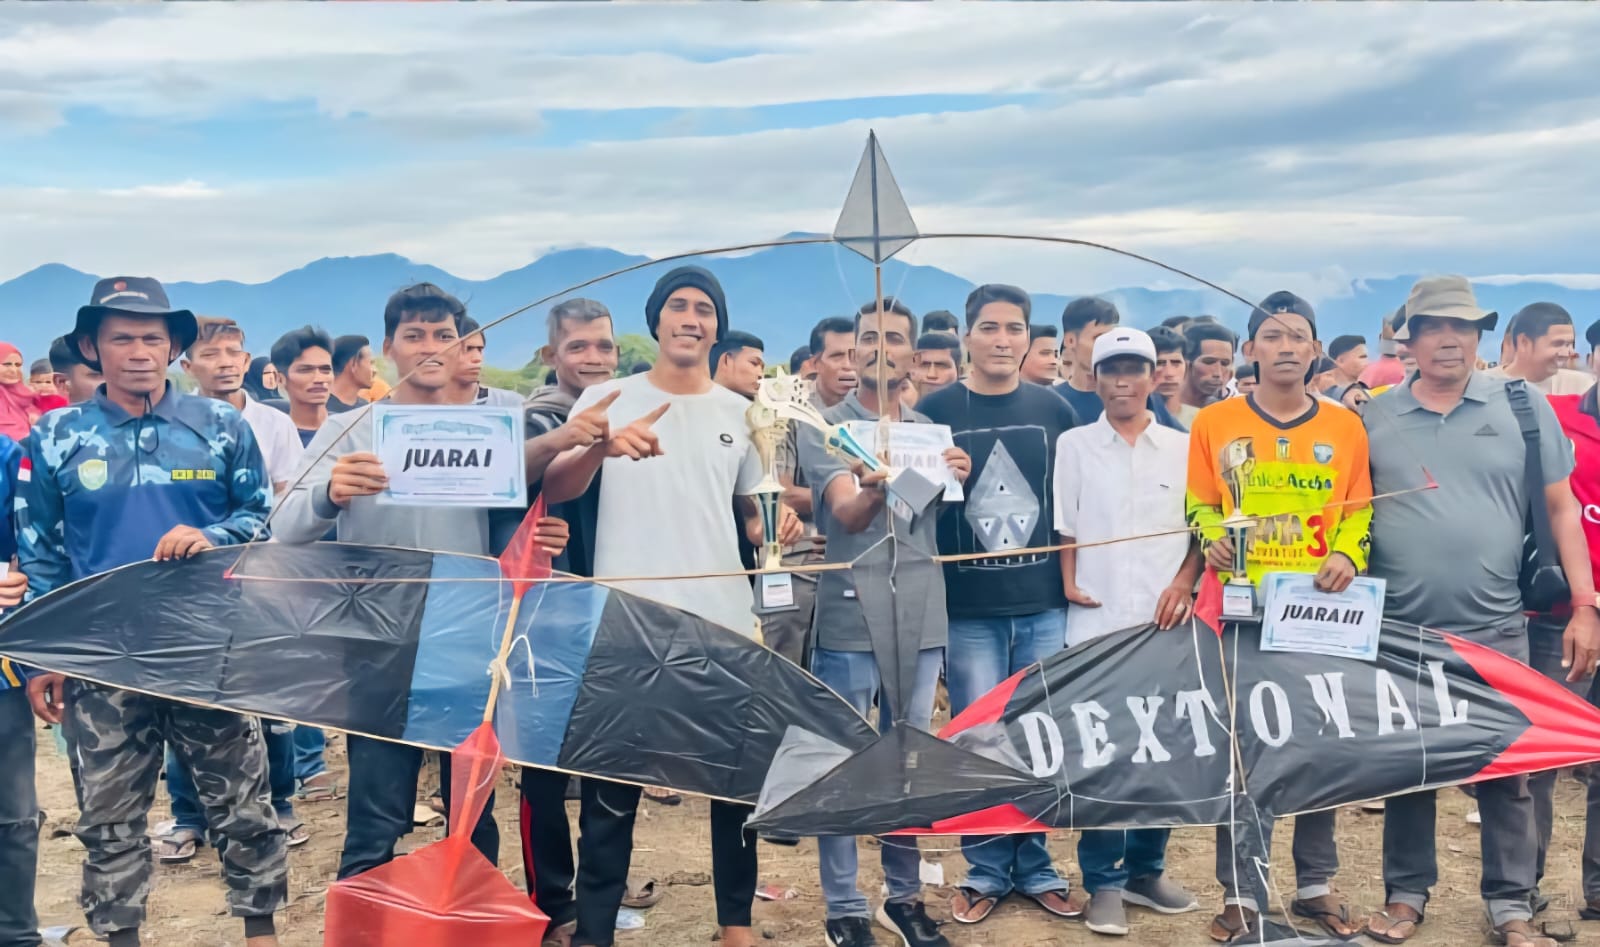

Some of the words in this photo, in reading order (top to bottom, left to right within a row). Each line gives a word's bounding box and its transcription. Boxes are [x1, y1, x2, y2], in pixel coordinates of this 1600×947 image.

[402, 448, 479, 472] JUARA
[483, 448, 493, 468] I
[1306, 514, 1329, 558] 3
[1280, 604, 1339, 624] JUARA
[1342, 609, 1365, 625] III
